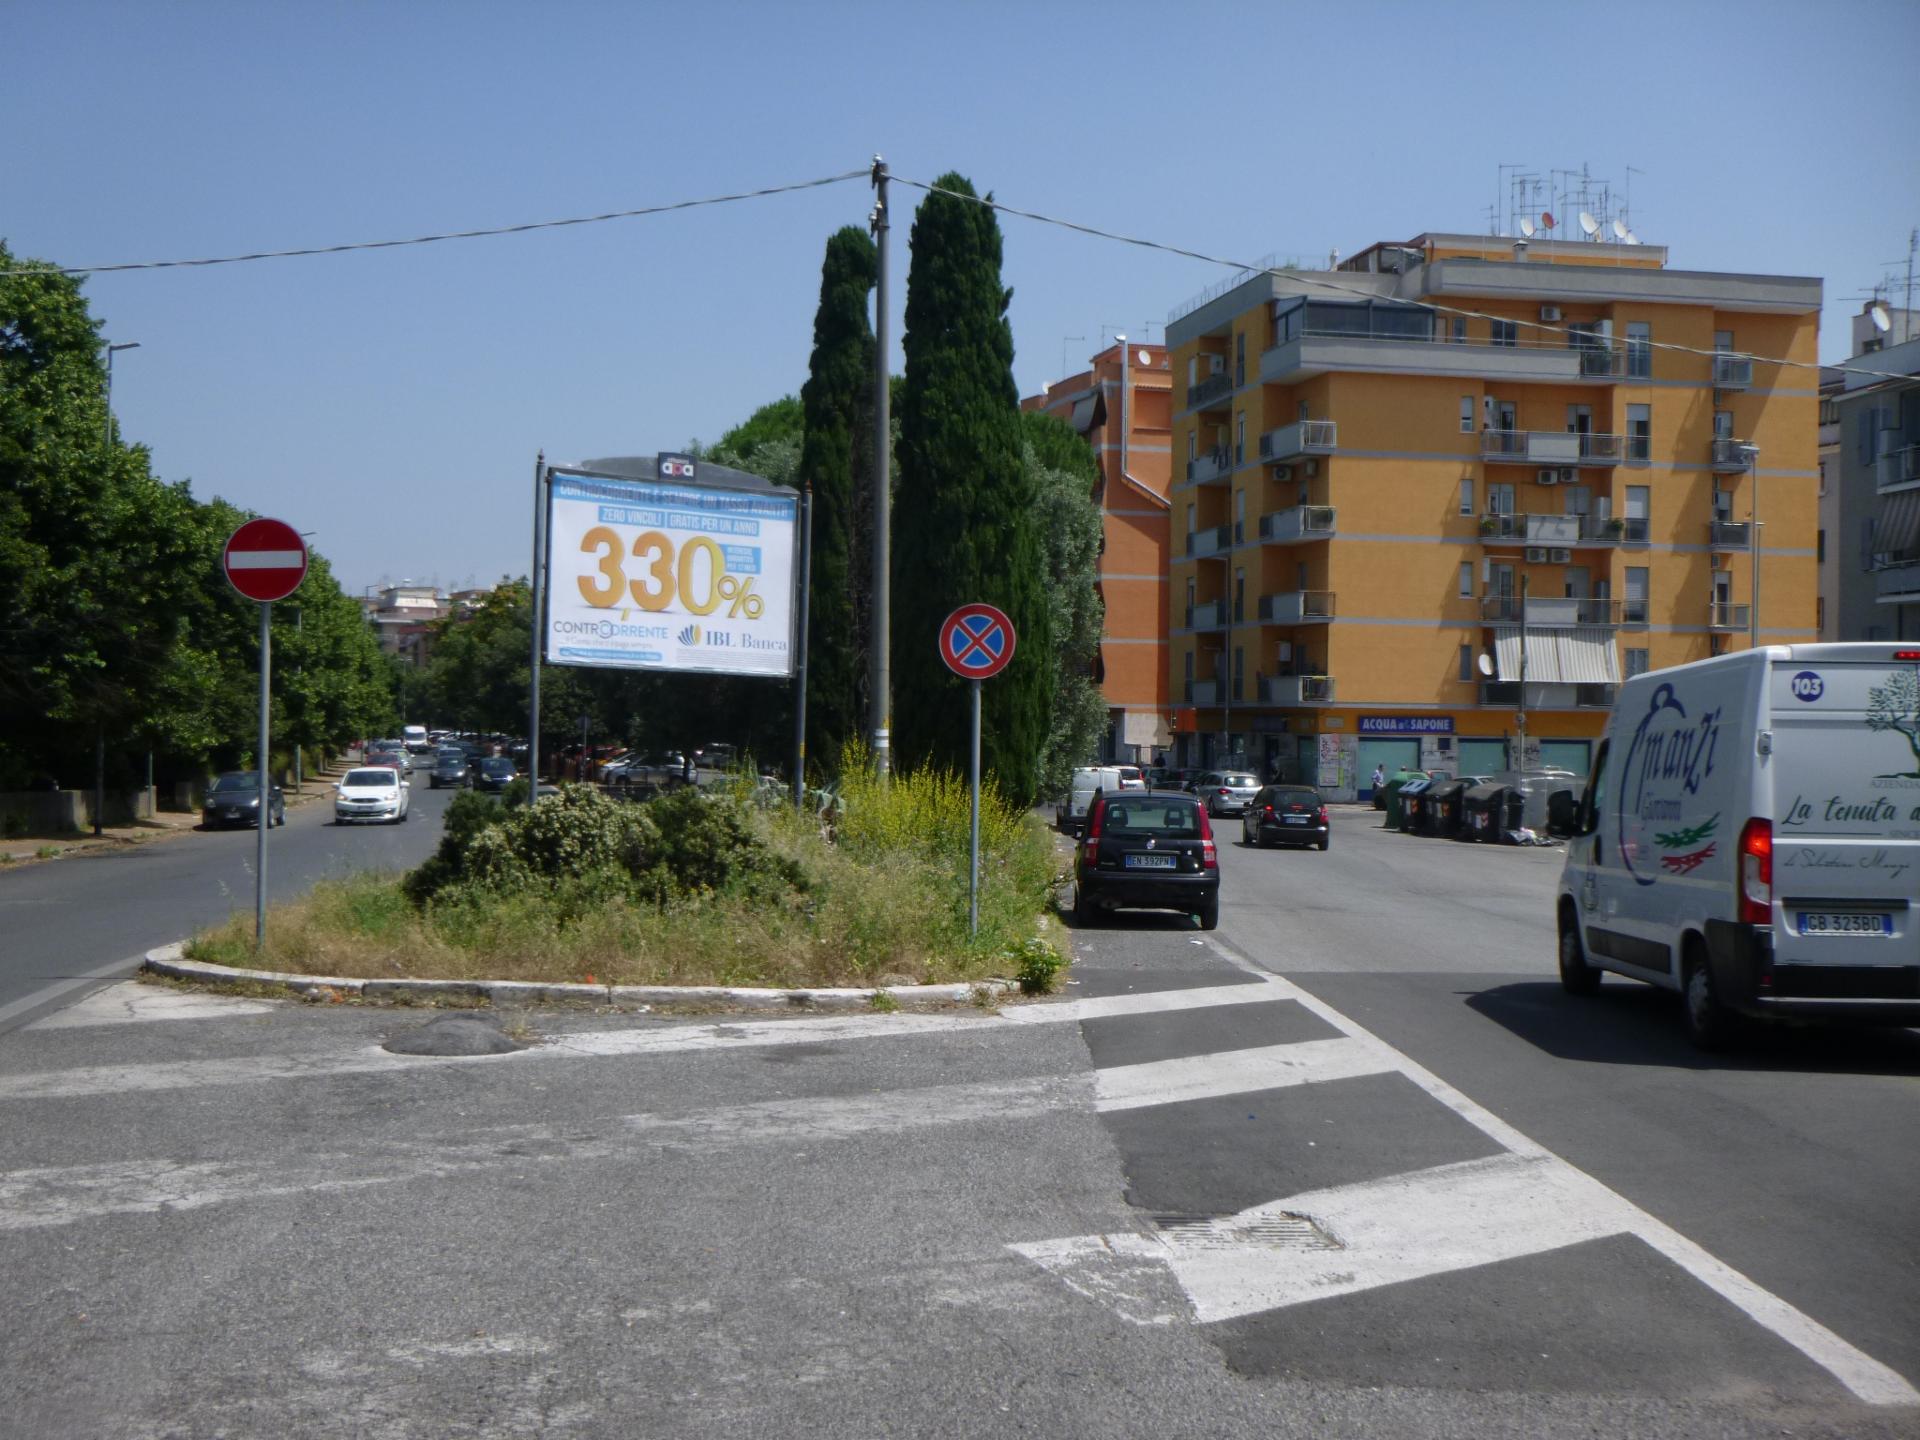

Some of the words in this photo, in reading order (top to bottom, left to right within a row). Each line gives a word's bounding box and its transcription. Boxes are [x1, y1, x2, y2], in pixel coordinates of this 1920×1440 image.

[603, 508, 625, 522] ZERO
[628, 510, 662, 526] VINCOLI
[670, 514, 700, 529] GRATIS
[702, 517, 718, 531] PER
[720, 519, 733, 532] UN
[734, 520, 757, 536] ANNO
[706, 630, 736, 647] IBL
[742, 633, 787, 651] Banca
[1793, 678, 1821, 696] 103
[1363, 718, 1397, 730] ACQUA
[1411, 719, 1449, 730] SAPONE
[1781, 795, 1812, 825] La
[1824, 796, 1896, 822] tenuta
[1132, 856, 1142, 865] EN
[1808, 916, 1826, 930] GB
[1832, 916, 1880, 931] 323BD
